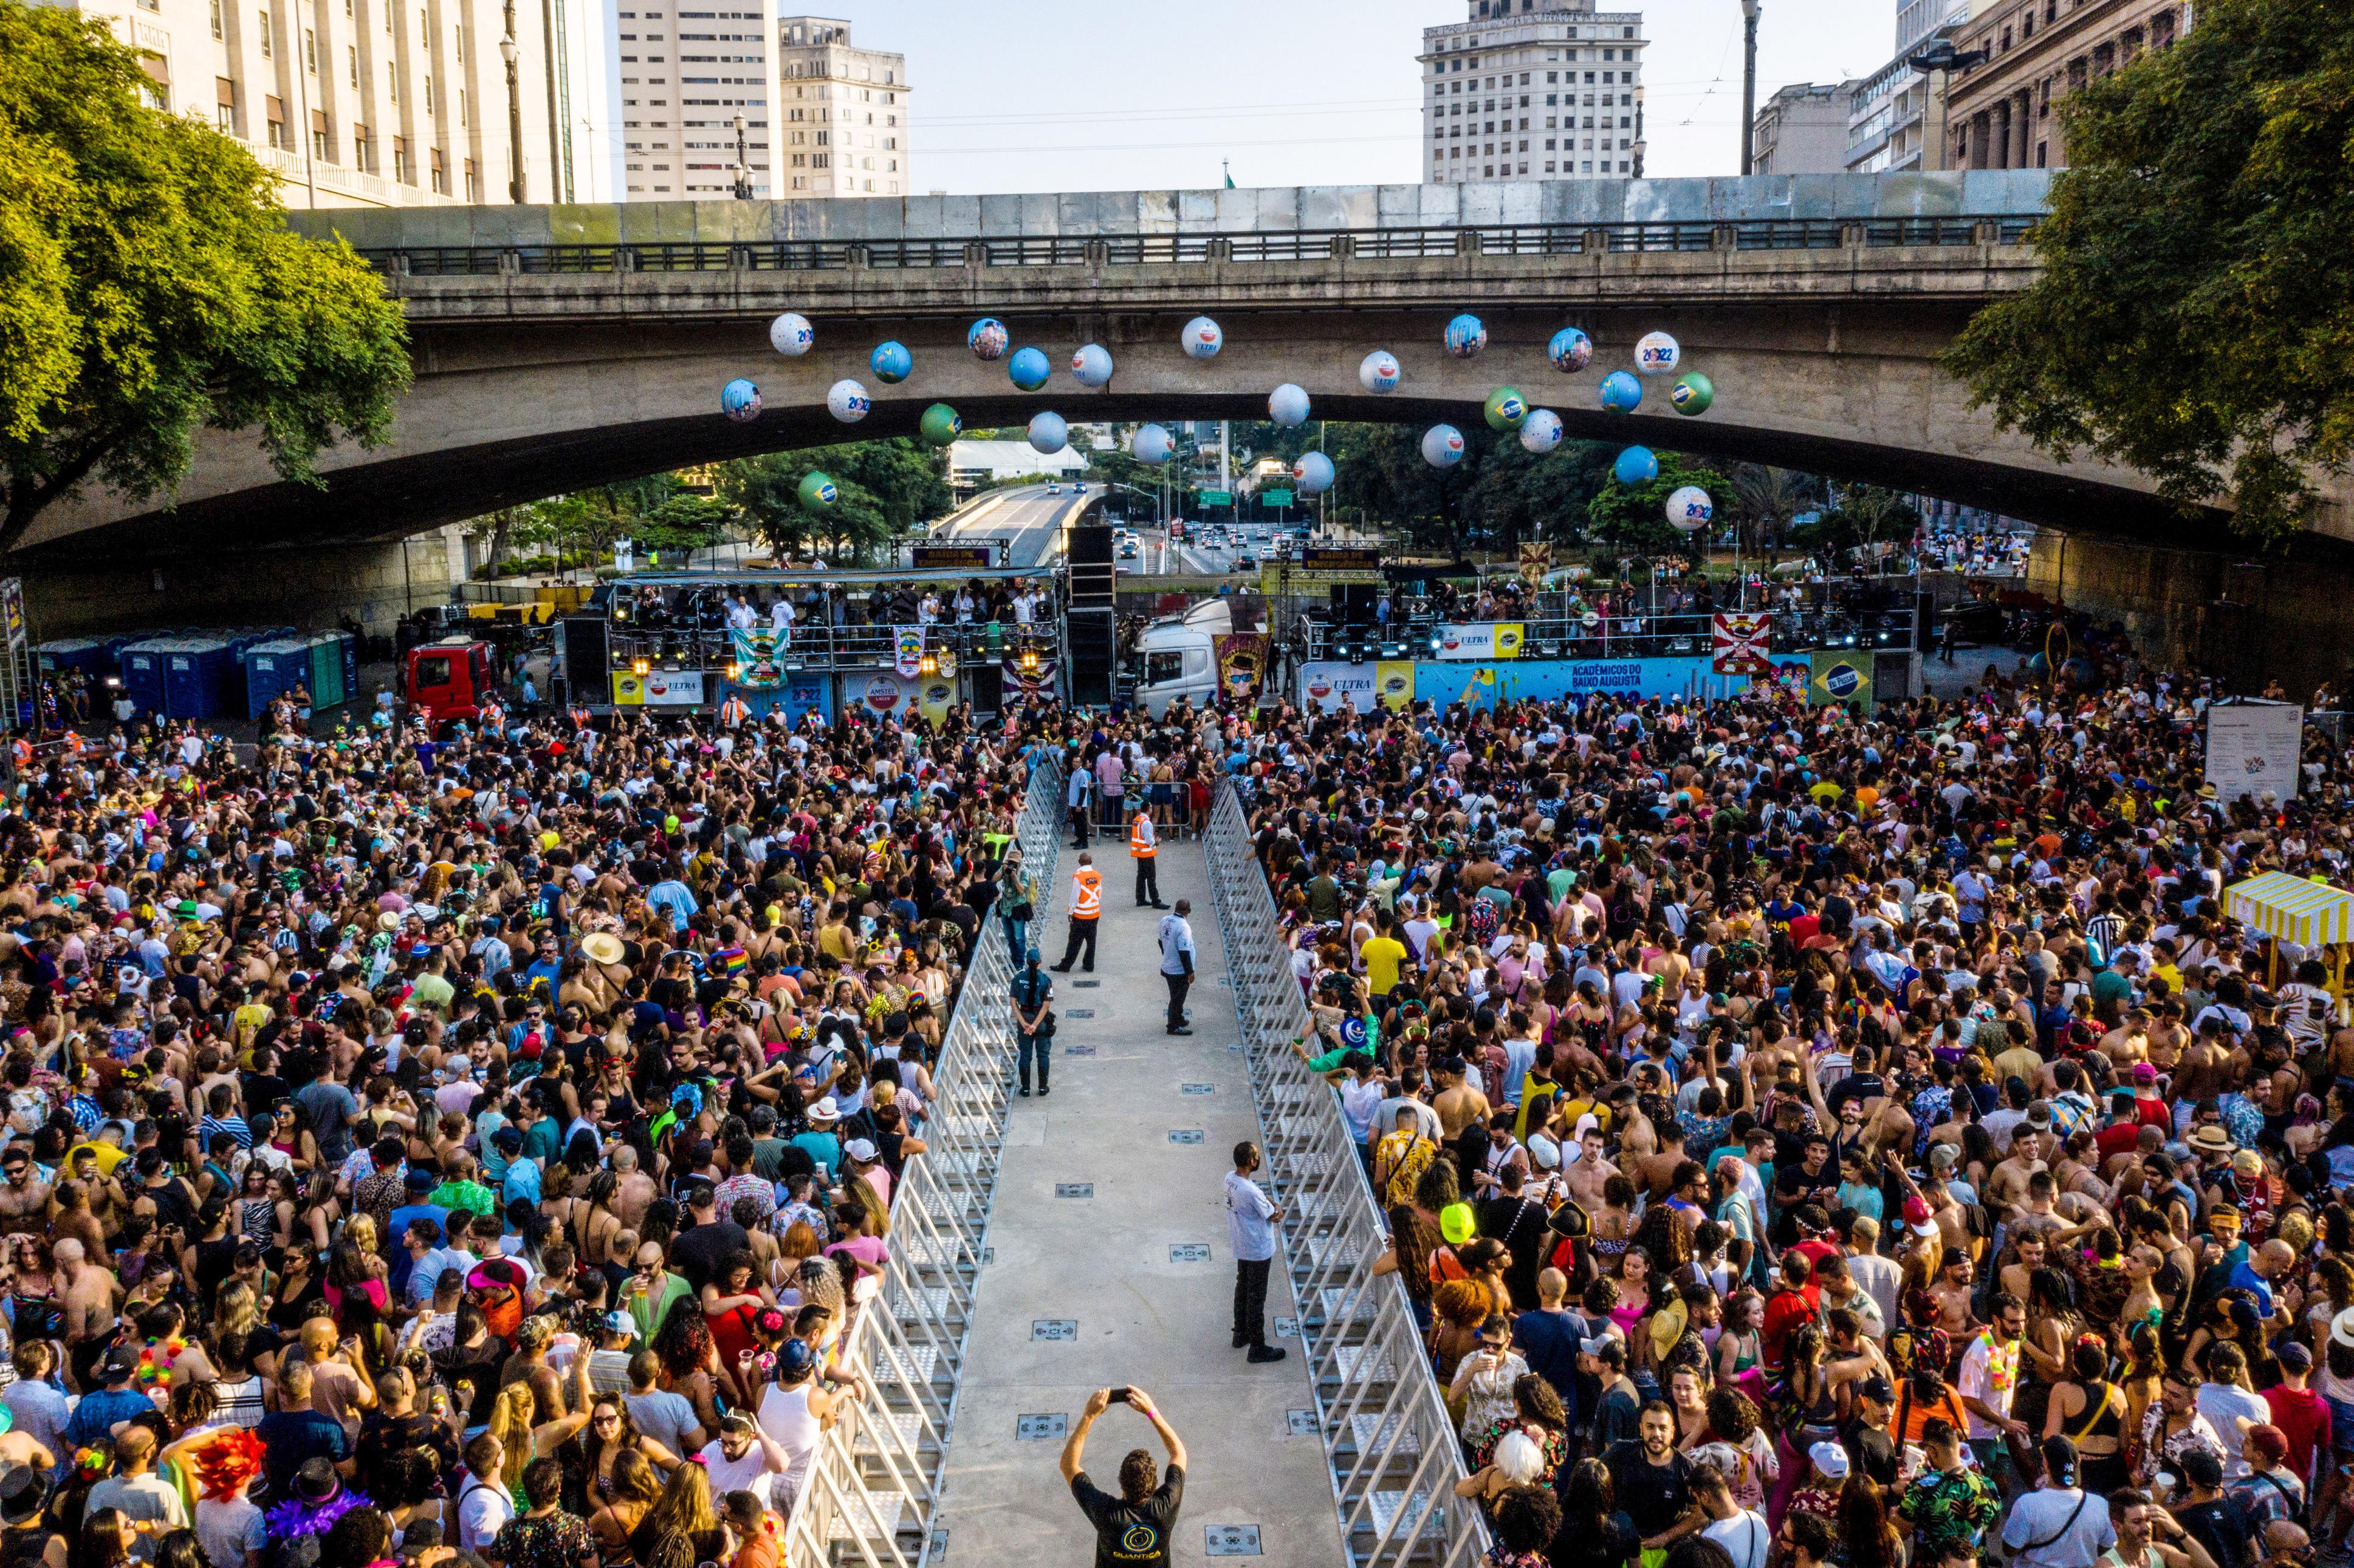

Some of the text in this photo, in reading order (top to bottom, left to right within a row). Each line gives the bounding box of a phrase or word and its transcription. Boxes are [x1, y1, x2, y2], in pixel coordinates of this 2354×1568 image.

[1642, 347, 1673, 361] 2022
[1572, 663, 1641, 676] ACADÊMICOS DO
[1334, 680, 1371, 689] ULTRA
[1572, 675, 1641, 687] BAIXO AUGUSTA
[792, 689, 820, 701] 2022
